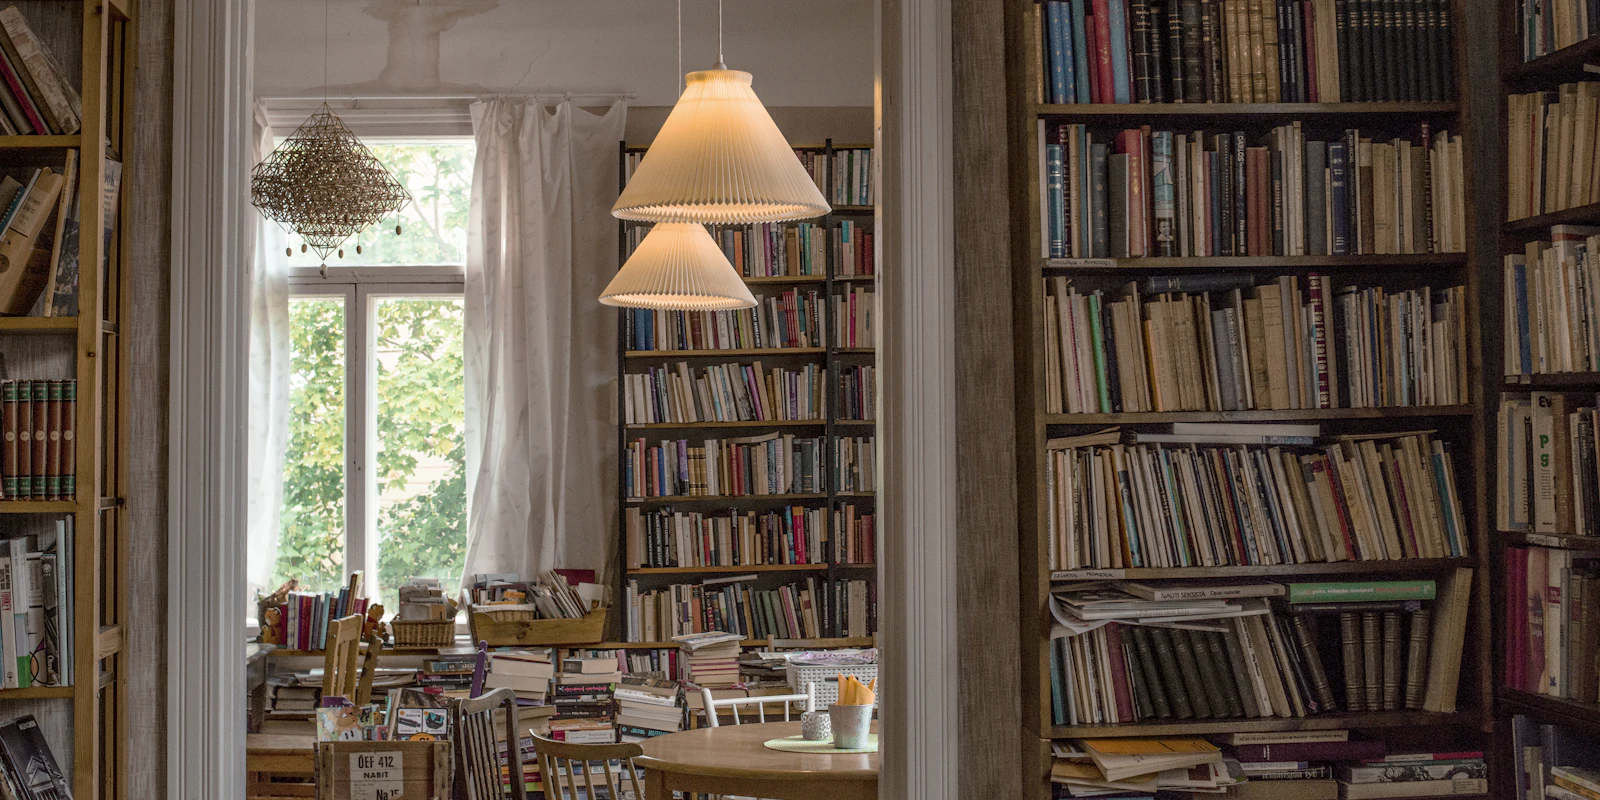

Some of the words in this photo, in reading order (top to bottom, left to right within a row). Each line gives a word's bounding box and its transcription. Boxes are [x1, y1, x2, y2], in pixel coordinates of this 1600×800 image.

[1180, 590, 1206, 598] SEKSISTÄ
[1, 591, 12, 612] TURKEY
[378, 755, 394, 768] 412
[363, 771, 389, 779] NABIT
